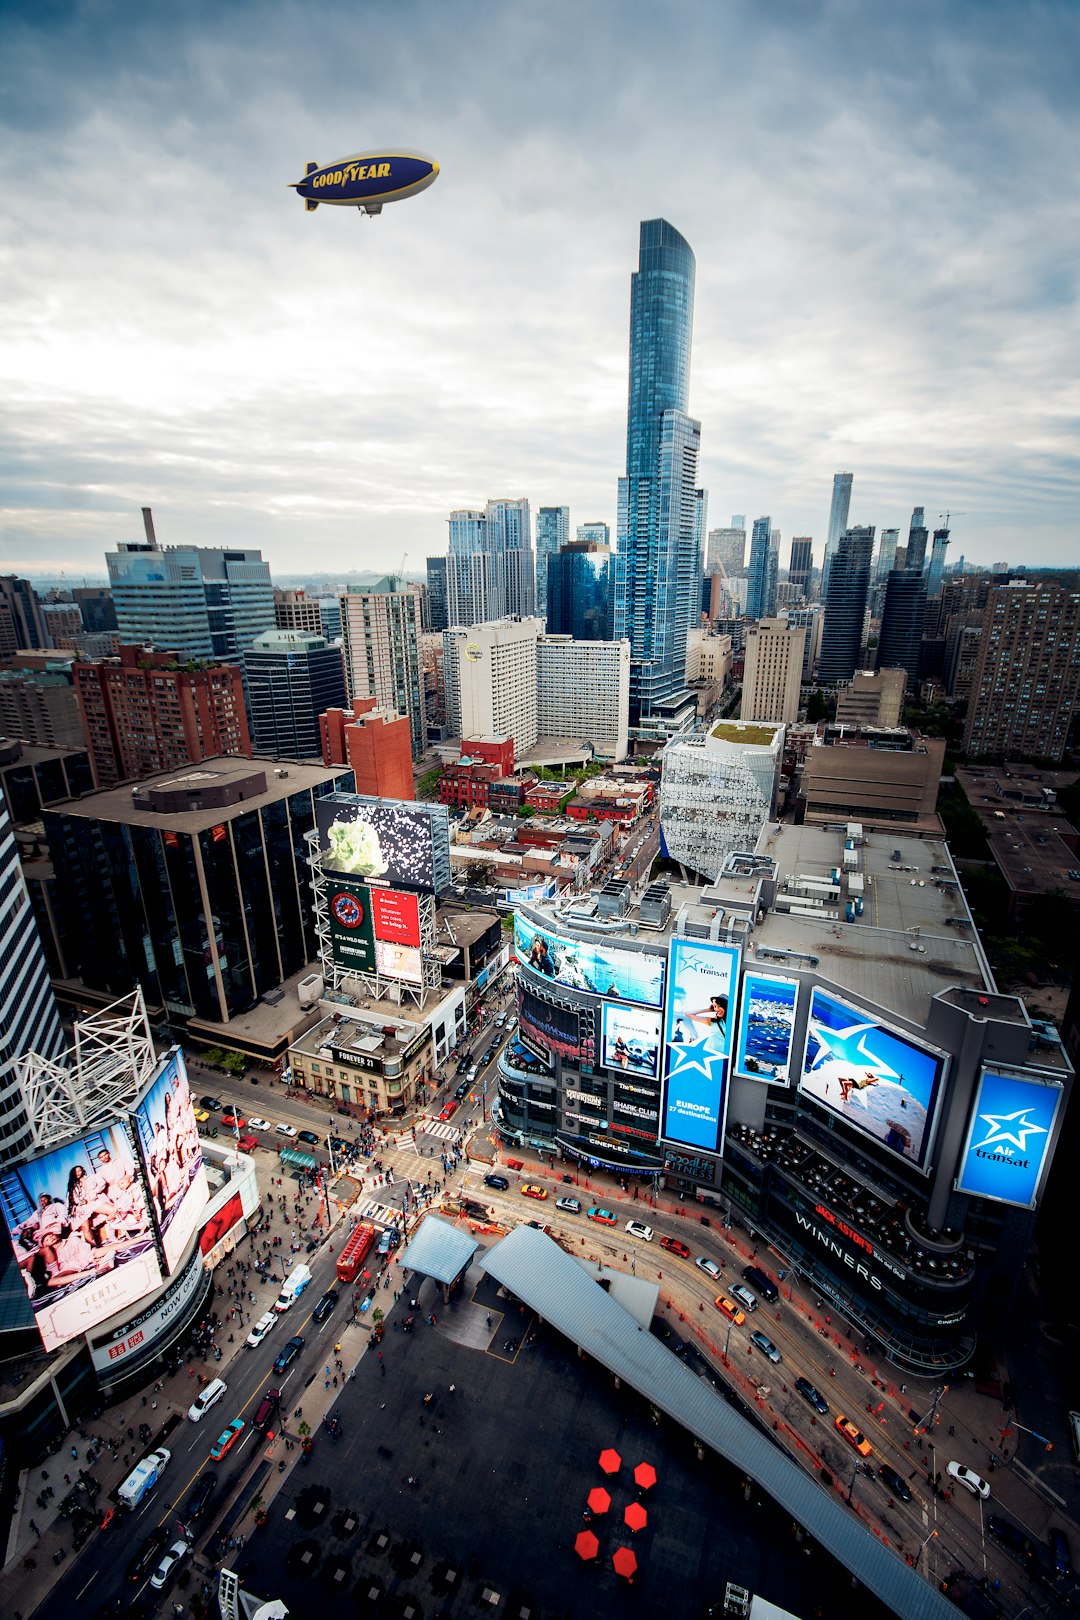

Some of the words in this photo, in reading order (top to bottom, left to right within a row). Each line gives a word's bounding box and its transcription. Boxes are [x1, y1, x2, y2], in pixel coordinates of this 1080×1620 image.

[312, 162, 391, 188] GOODYEAR
[700, 968, 728, 978] transat
[339, 1051, 366, 1066] FOREVER
[366, 1059, 374, 1068] 21
[613, 1100, 637, 1113] SHARK
[638, 1107, 658, 1118] CLUB
[676, 1100, 711, 1114] EUROPE
[678, 1108, 717, 1123] destinations
[589, 1138, 629, 1153] CINEPLEX
[993, 1145, 1016, 1156] Air
[976, 1148, 1030, 1169] transat
[665, 1160, 713, 1181] FITNESS
[815, 1203, 836, 1226] JACK
[837, 1221, 873, 1254] ASTOR'S
[796, 1212, 882, 1290] WINNERS
[84, 1281, 118, 1307] FENTY
[112, 1325, 130, 1339] CF
[130, 1299, 164, 1329] Toronto
[165, 1276, 185, 1300] Eaton
[160, 1292, 181, 1321] NOW
